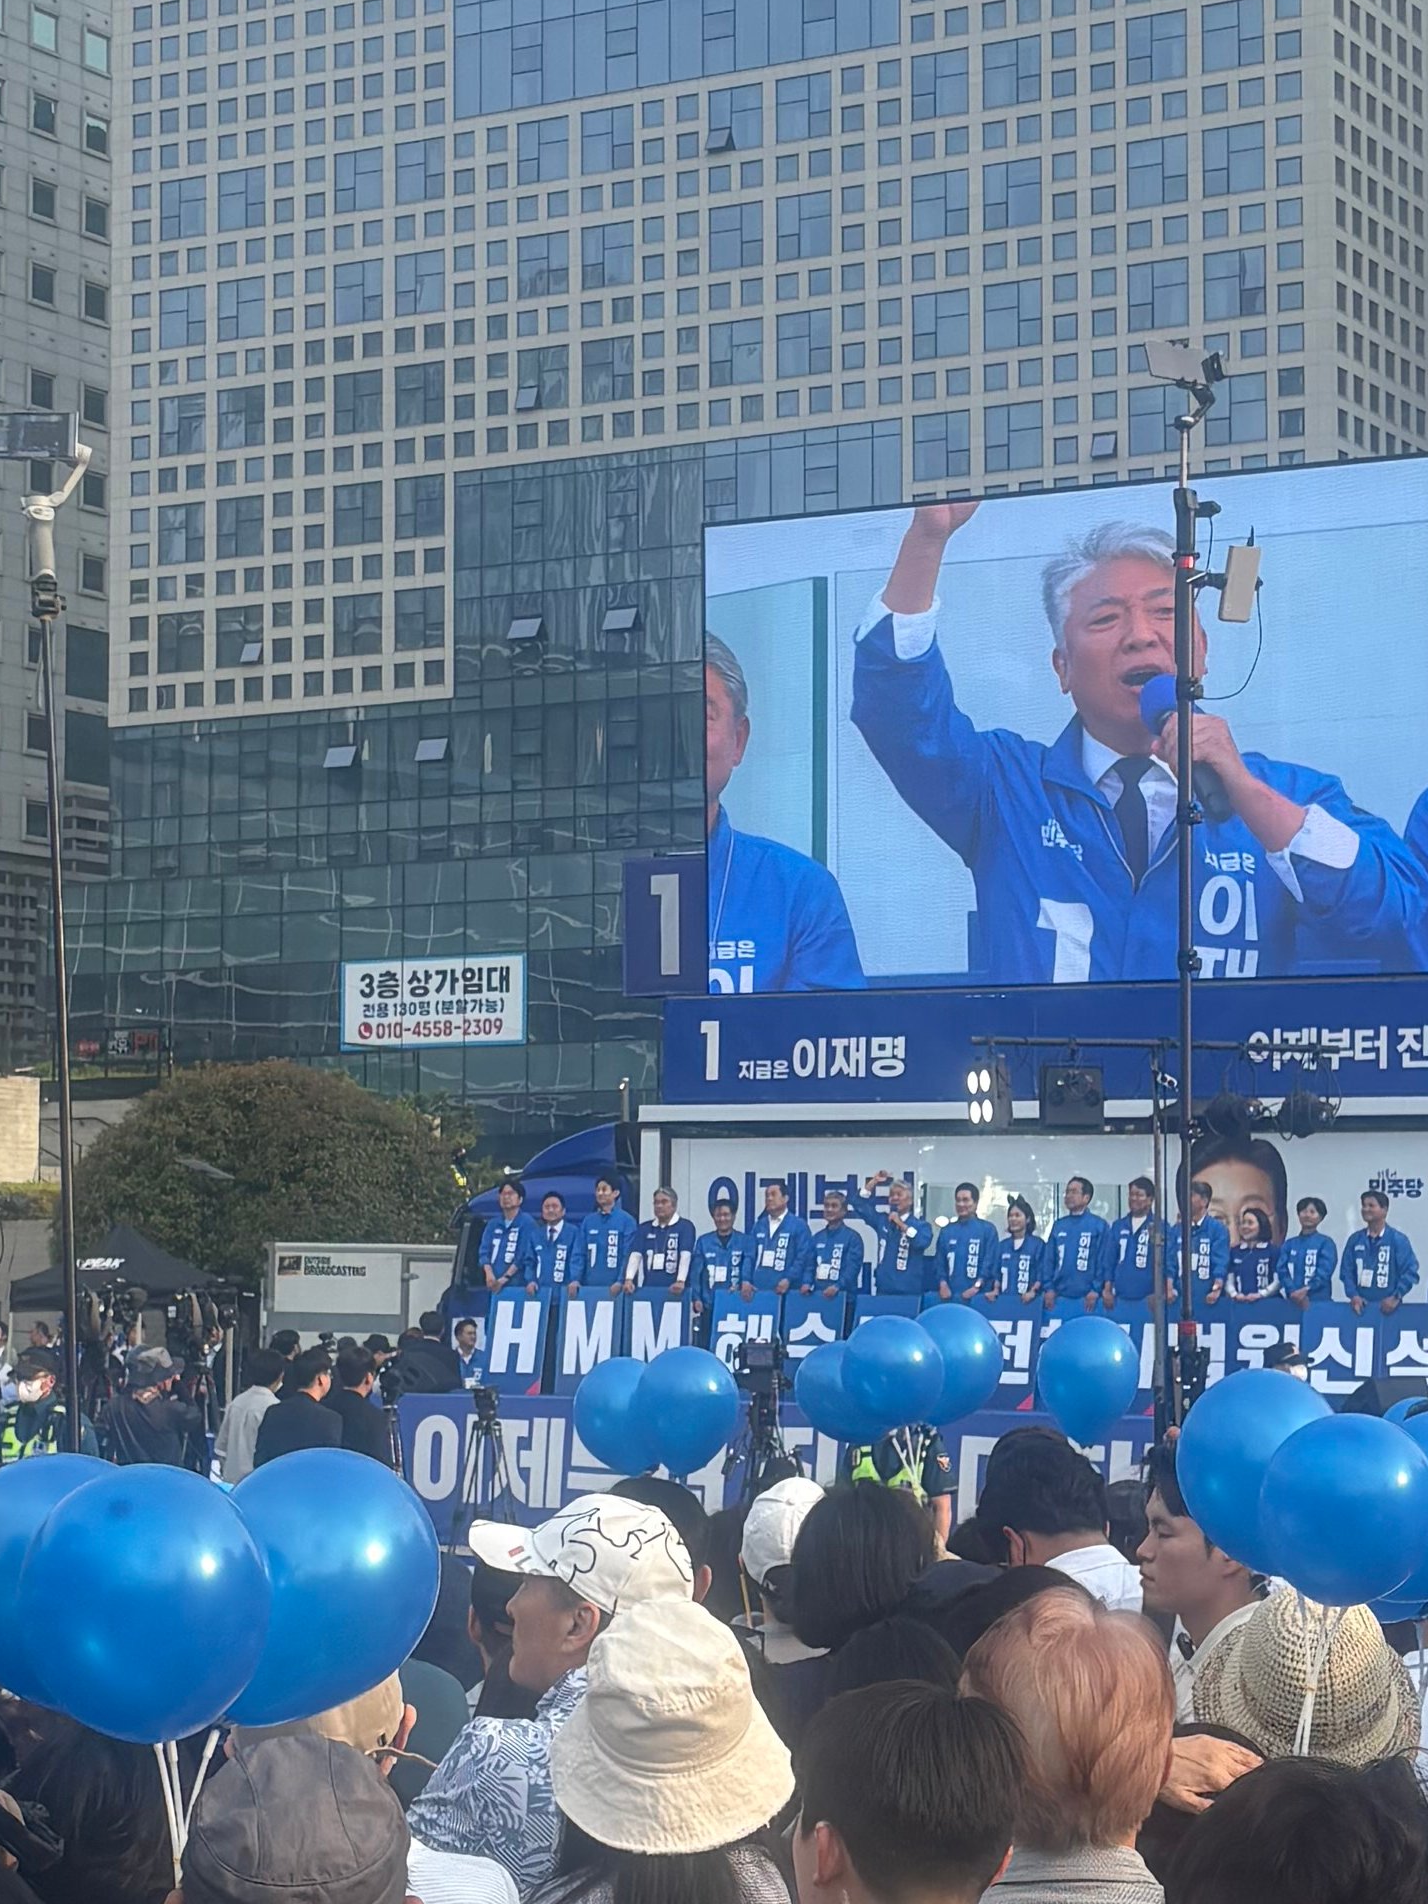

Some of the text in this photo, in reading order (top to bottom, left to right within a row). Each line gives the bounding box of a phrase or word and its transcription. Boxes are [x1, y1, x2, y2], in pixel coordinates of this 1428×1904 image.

[650, 874, 680, 976] 1
[359, 966, 511, 999] 3층 상가임대
[375, 1017, 504, 1040] 010-4558-2309
[700, 1020, 906, 1081] 1 지금은 이재명
[1247, 1024, 1388, 1072] 이제부터
[81, 1257, 125, 1271] PEAK
[489, 1300, 682, 1376] HMM
